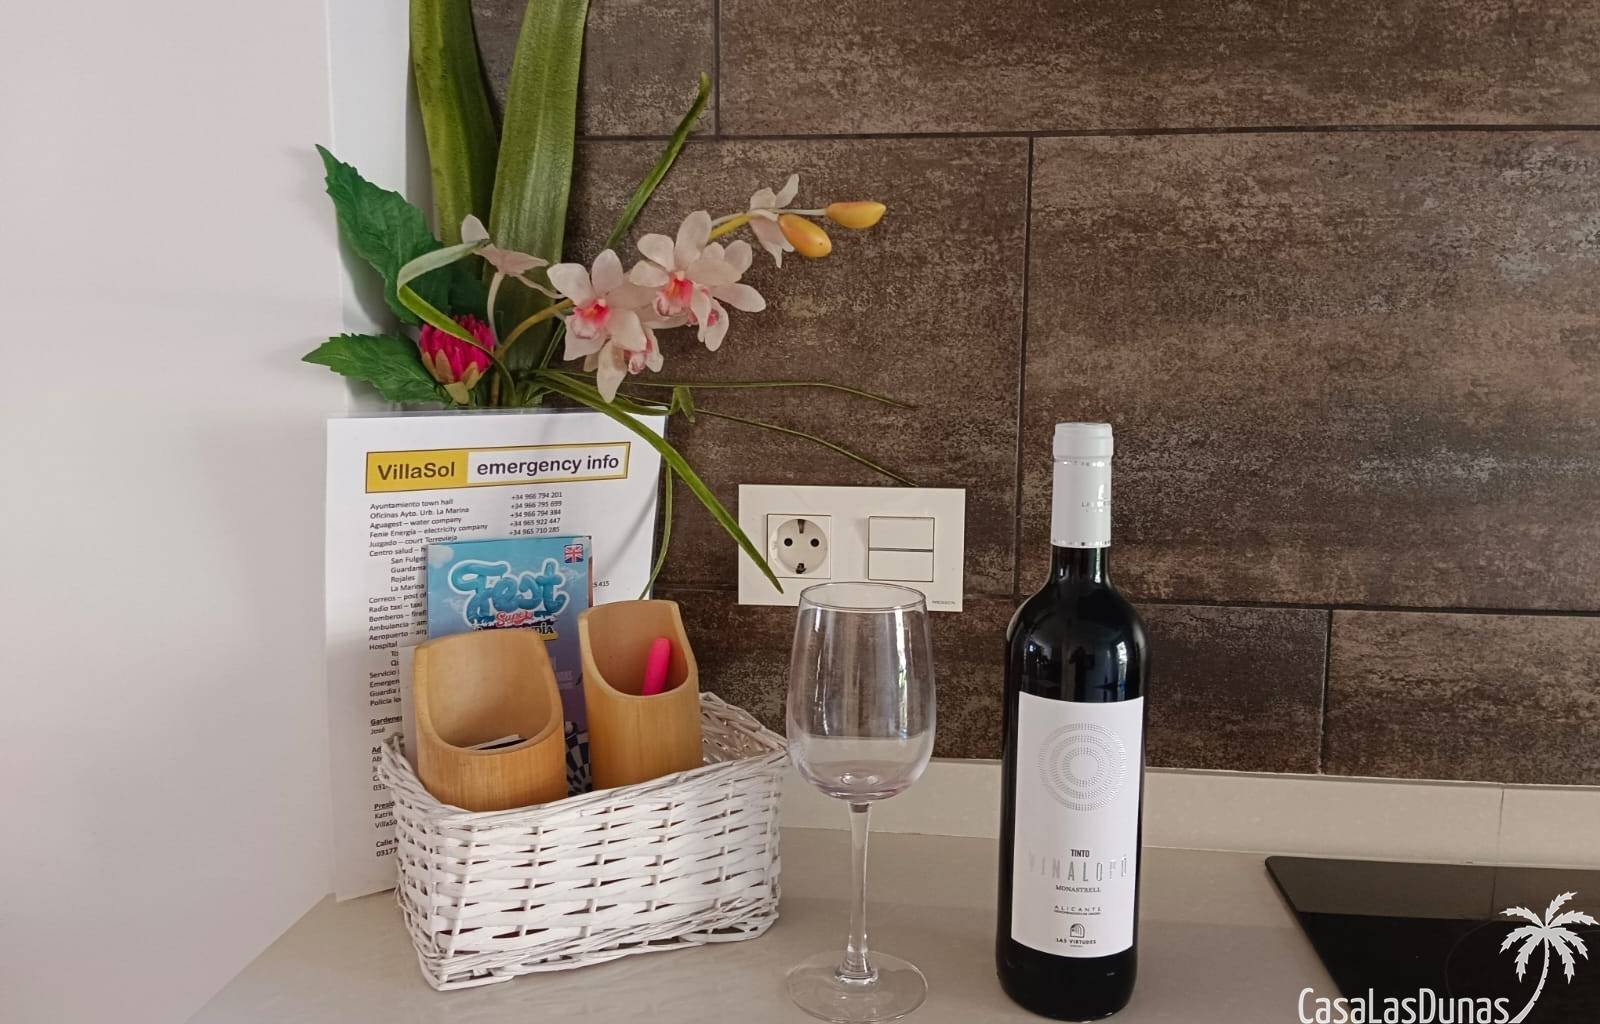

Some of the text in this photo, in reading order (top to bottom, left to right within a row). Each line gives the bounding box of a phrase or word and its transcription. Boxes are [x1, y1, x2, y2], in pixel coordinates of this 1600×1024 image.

[377, 454, 619, 481] VillaSol emergency info
[370, 501, 420, 510] Ayuntamiento
[370, 511, 398, 519] Oficinas
[370, 521, 402, 530] Aguagest
[431, 517, 462, 525] company
[424, 526, 457, 534] electricity
[458, 523, 489, 531] company
[369, 540, 397, 548] Juzgado
[369, 549, 393, 557] Centro
[391, 557, 403, 565] San
[391, 575, 415, 583] Rojales
[400, 583, 424, 591] Marina
[449, 559, 569, 627] Fest
[369, 596, 396, 604] Correos
[403, 593, 418, 601] post
[369, 605, 388, 613] Radio
[369, 614, 404, 622] Bomberos
[369, 622, 409, 631] Ambulancia
[369, 631, 408, 640] Aeropuerto
[369, 641, 397, 650] Hospital
[369, 670, 396, 678] Servicio
[369, 688, 397, 697] Guardia
[376, 839, 393, 848] Calle
[376, 847, 398, 857] 03177
[1071, 849, 1090, 857] TINTO
[1055, 884, 1101, 893] MONASTRELL
